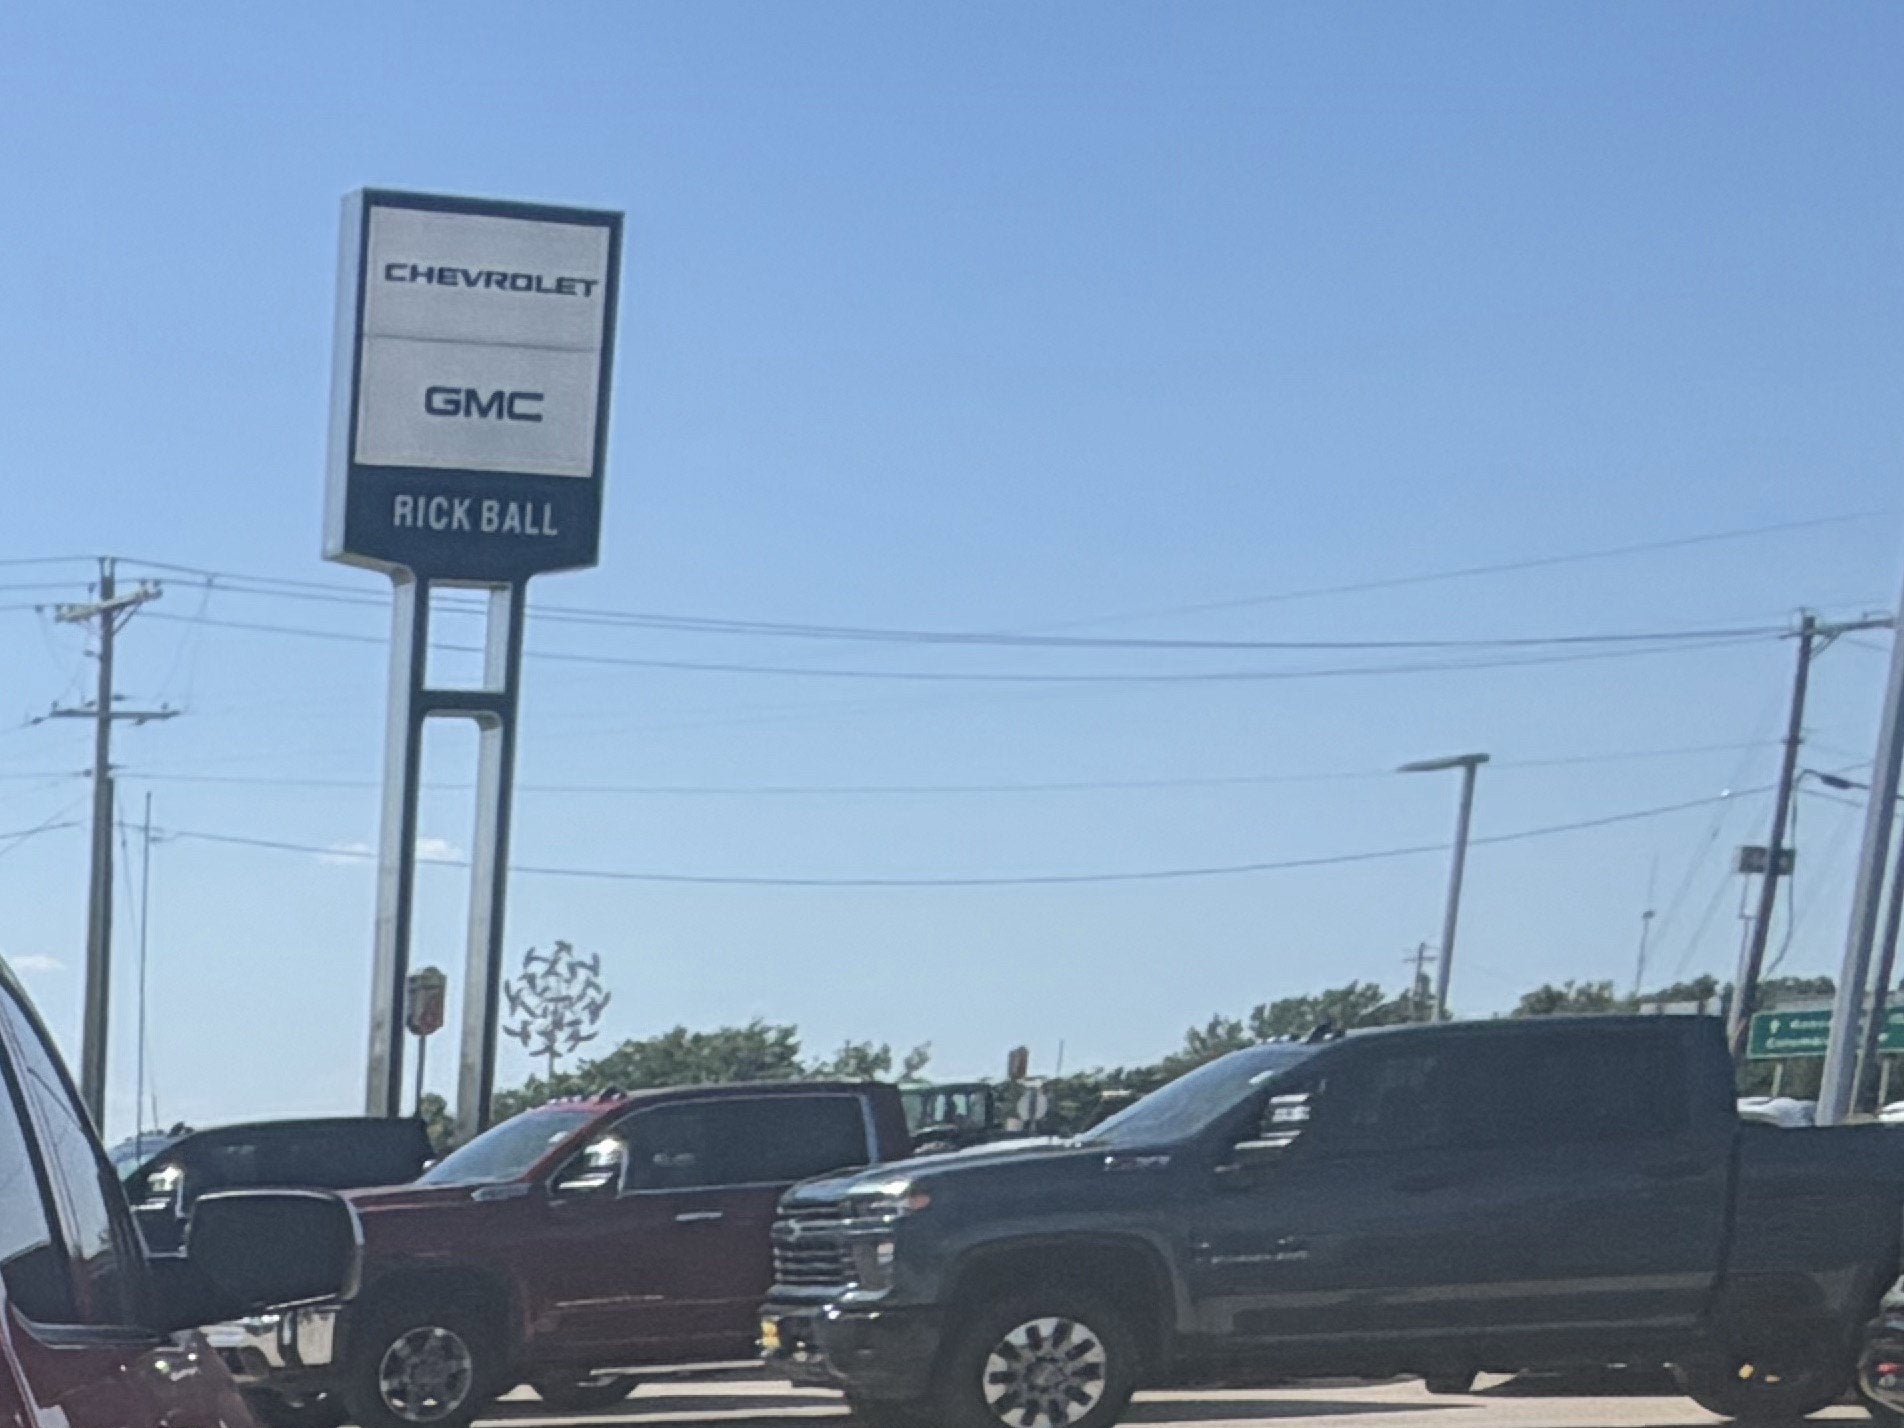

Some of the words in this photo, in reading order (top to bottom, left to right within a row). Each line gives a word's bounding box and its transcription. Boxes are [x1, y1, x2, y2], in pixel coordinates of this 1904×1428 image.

[384, 263, 599, 298] CHEVROLET
[424, 385, 544, 422] GMC
[394, 494, 471, 532] RICK
[480, 499, 558, 537] BALL
